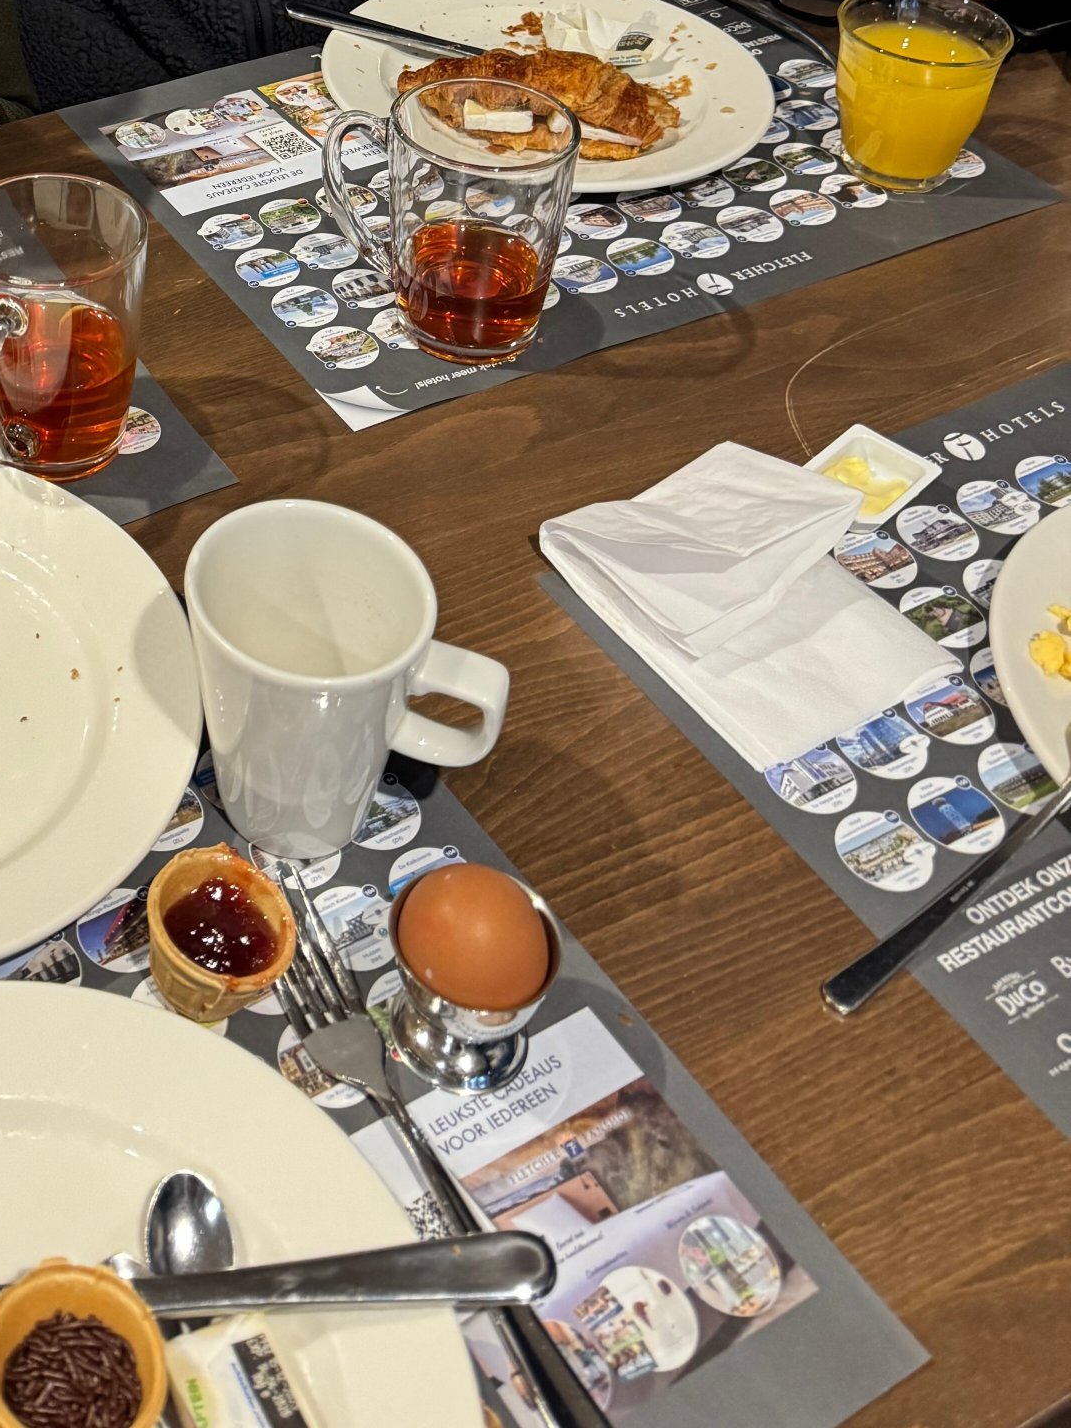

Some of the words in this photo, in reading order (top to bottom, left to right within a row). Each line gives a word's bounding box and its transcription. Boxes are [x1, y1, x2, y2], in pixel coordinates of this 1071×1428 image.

[212, 174, 258, 190] IEDEREEN
[254, 172, 291, 187] LEUKSTE
[259, 167, 286, 178] VOOR
[291, 169, 304, 177] DE
[206, 186, 251, 200] CADEAUS
[730, 251, 814, 281] FLETCHER
[613, 287, 699, 318] HOTELS
[414, 374, 450, 390] hotels!
[451, 366, 477, 379] meer
[980, 401, 1065, 443] HOTELS
[965, 877, 1042, 924] ONTDEK
[1036, 854, 1071, 887] ONZ
[936, 886, 1071, 973] RESTAURANTCO
[995, 980, 1047, 1017] DuCo
[429, 1094, 492, 1136] LEUKSTE
[492, 1055, 562, 1101] CADEAUS
[437, 1123, 488, 1155] VOOR
[486, 1082, 558, 1131] IEDEREEN
